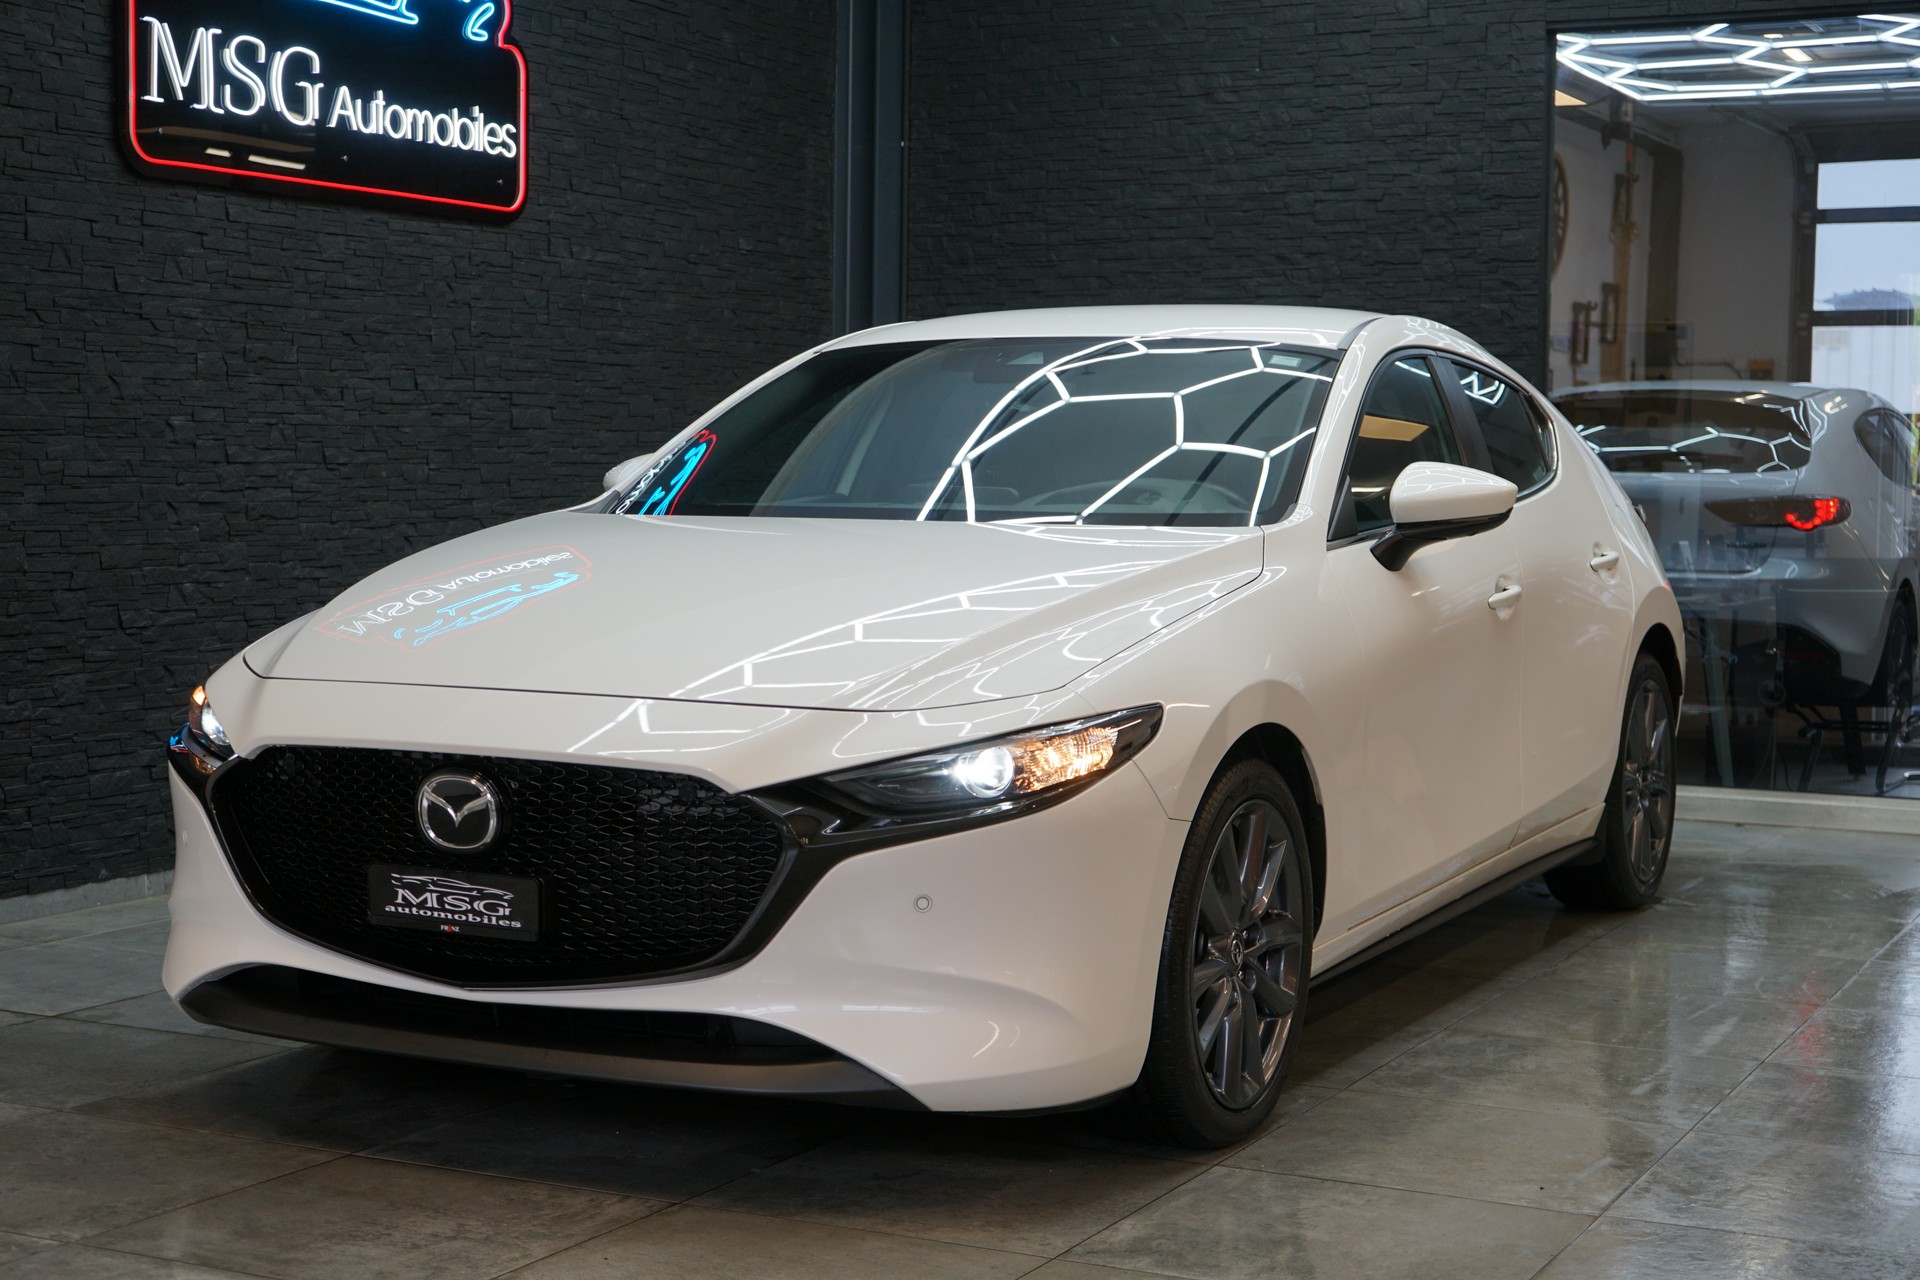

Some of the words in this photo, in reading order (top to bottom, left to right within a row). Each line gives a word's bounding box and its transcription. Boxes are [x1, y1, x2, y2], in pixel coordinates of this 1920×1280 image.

[140, 16, 325, 126] MSG
[326, 86, 518, 158] Automobiles
[385, 904, 522, 928] automobiles
[394, 888, 512, 916] MSG
